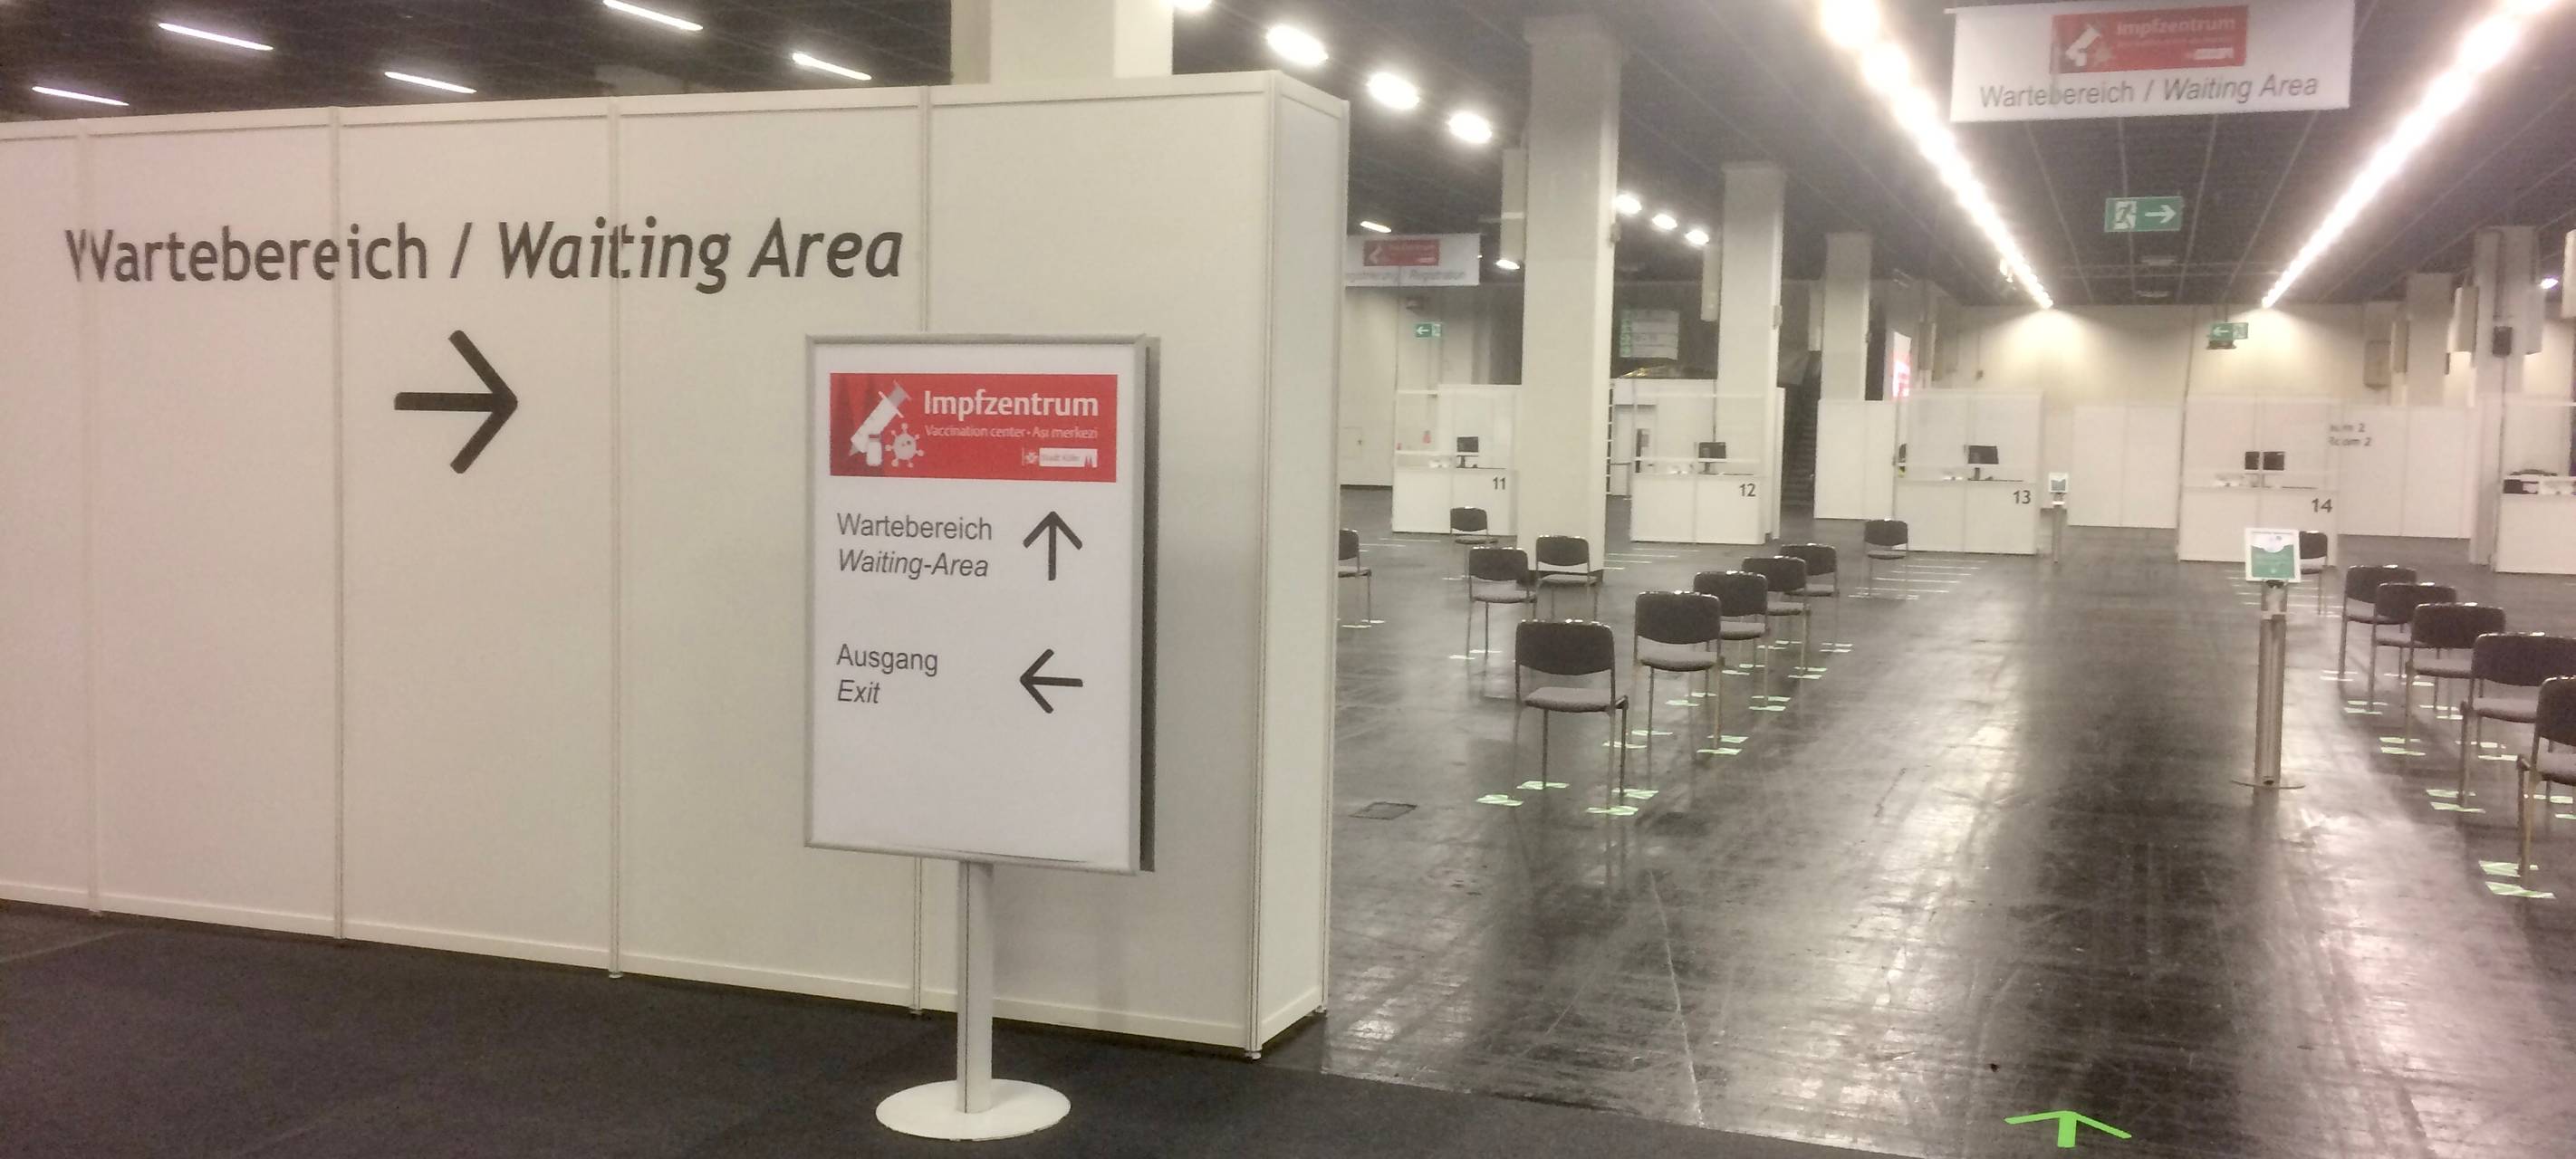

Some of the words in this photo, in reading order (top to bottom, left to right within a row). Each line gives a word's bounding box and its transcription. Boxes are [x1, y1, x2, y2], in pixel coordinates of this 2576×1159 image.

[1979, 80, 2134, 108] Wartebereich
[2164, 78, 2253, 104] Waiting
[2258, 73, 2319, 97] Area
[64, 221, 428, 283] Wartebereich
[498, 215, 732, 295] Waiting
[747, 216, 904, 278] Area
[924, 388, 1099, 422] Impfzentrum
[925, 425, 988, 437] Vaccination
[990, 426, 1025, 438] center
[1493, 476, 1506, 490] 11
[1739, 483, 1756, 497] 12
[2013, 490, 2031, 504] 13
[2312, 498, 2332, 513] 14
[837, 512, 993, 541] Wartebereich
[839, 548, 989, 580] Waiting-Area
[836, 643, 938, 677] Ausgang
[838, 679, 881, 704] Exit
